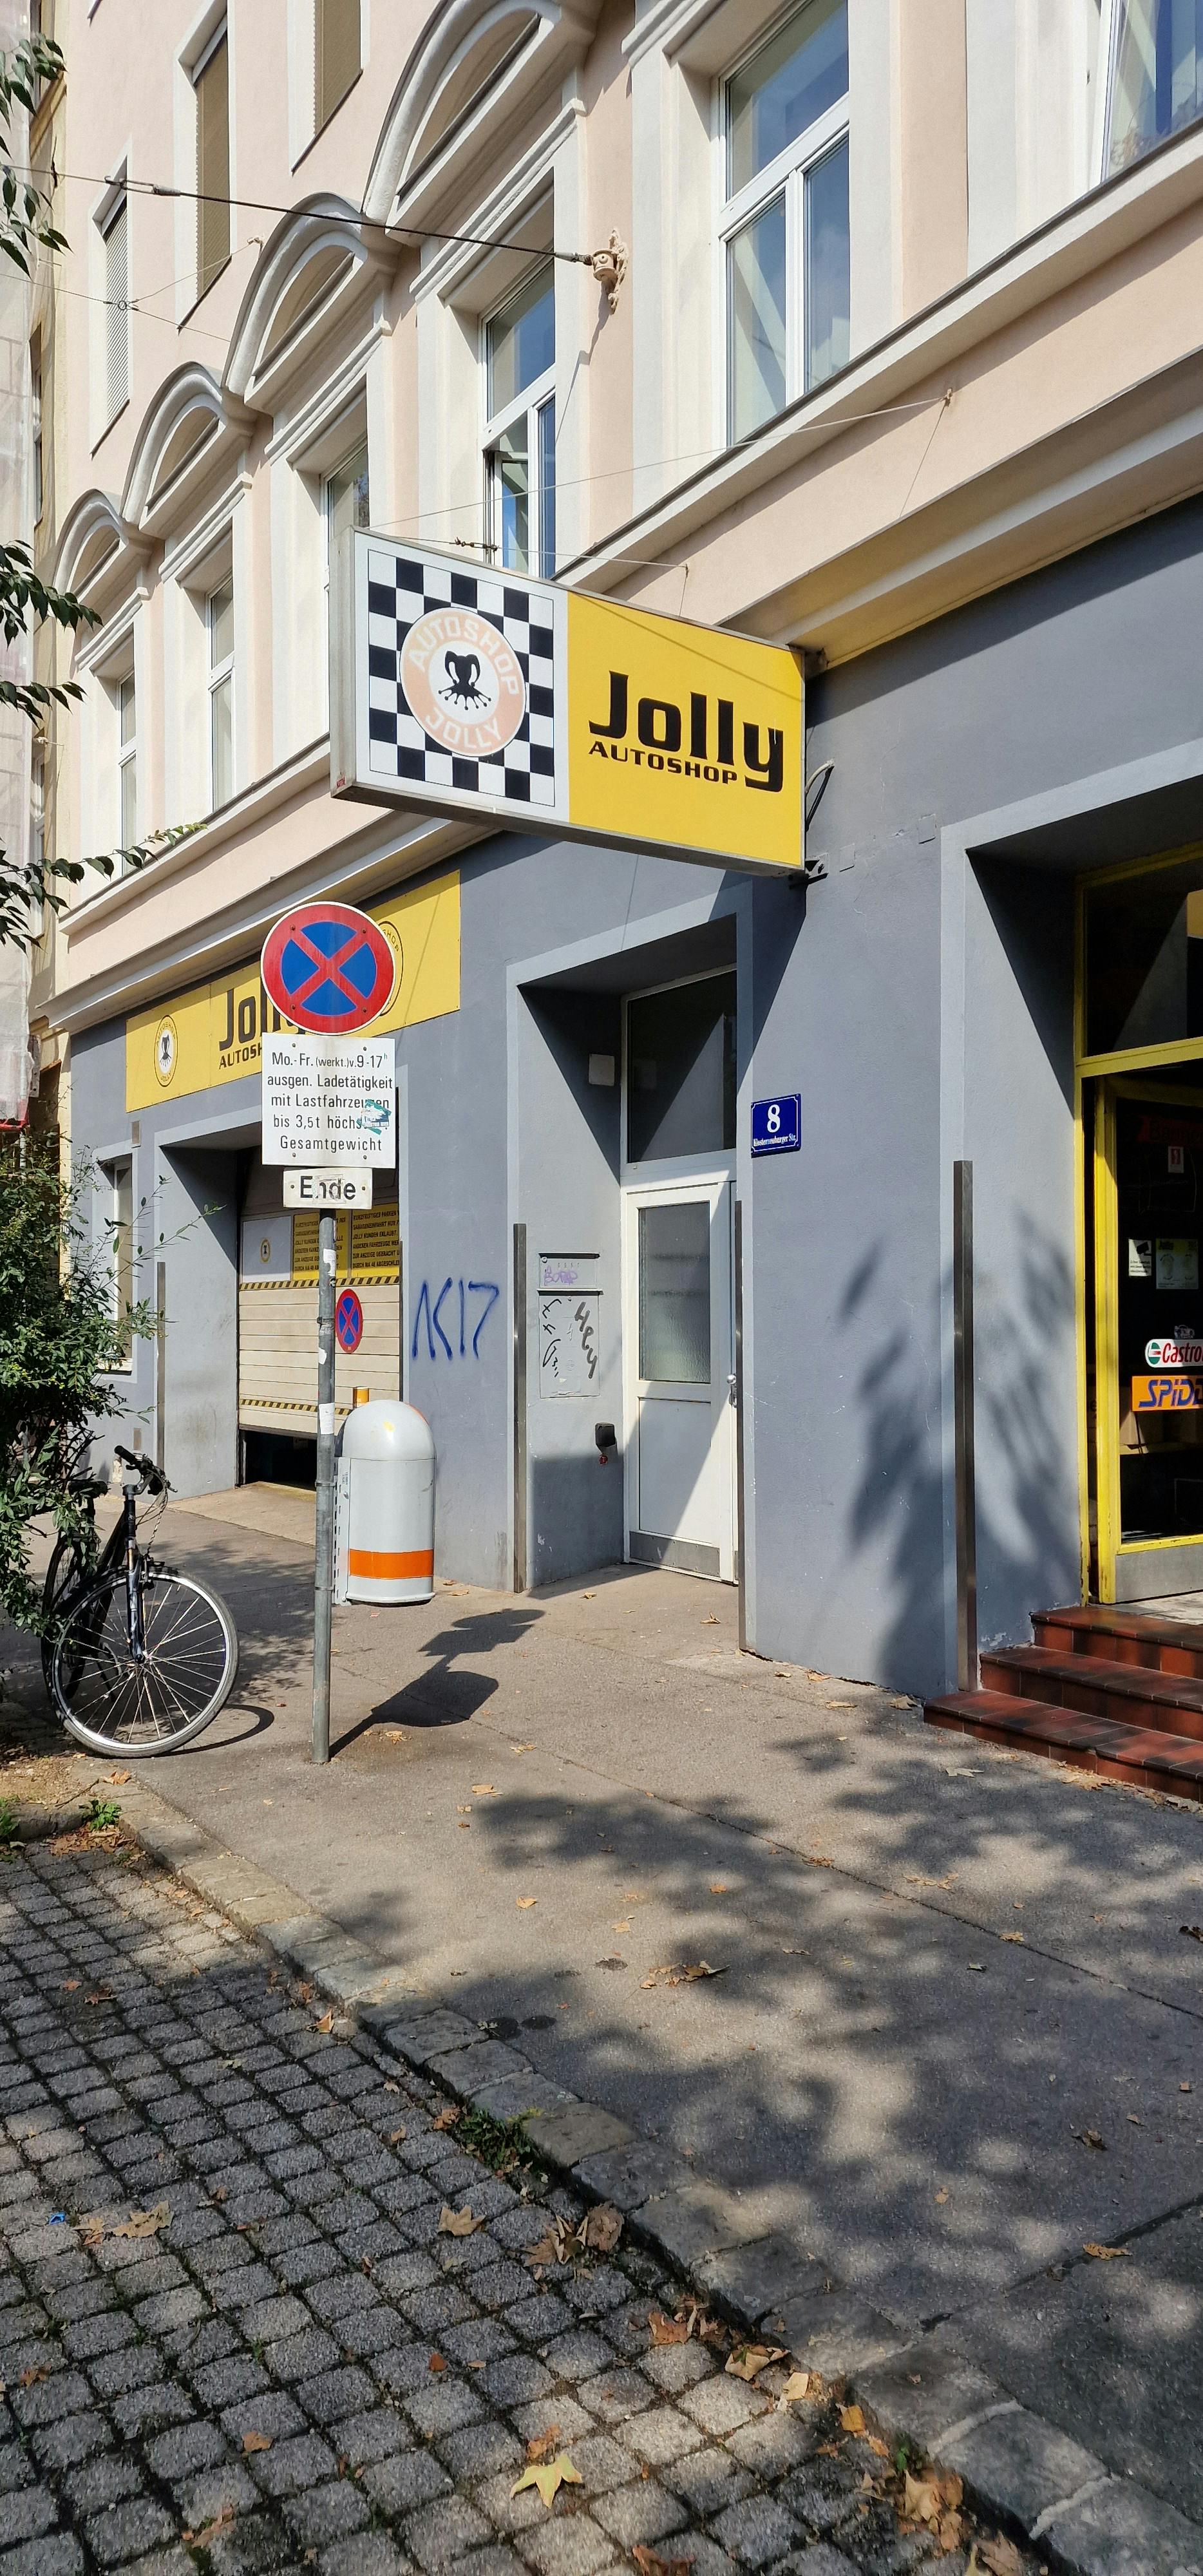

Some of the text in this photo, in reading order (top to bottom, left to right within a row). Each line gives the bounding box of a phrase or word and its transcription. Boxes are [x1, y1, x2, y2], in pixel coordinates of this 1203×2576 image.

[408, 614, 519, 696] AUTOSHOP
[425, 706, 502, 749] JOLLY
[589, 670, 784, 793] Jolly
[589, 741, 737, 784] AUTOSHOP
[267, 1074, 393, 1091] ausgen. Ladetätigkeit
[271, 1093, 291, 1107] mit
[273, 1114, 290, 1128] bis
[296, 1115, 320, 1130] 3,5t
[767, 1104, 781, 1133] 8
[280, 1135, 382, 1153] Gesamtgewicht
[299, 1175, 356, 1200] Ende
[1162, 1343, 1203, 1363] Castro
